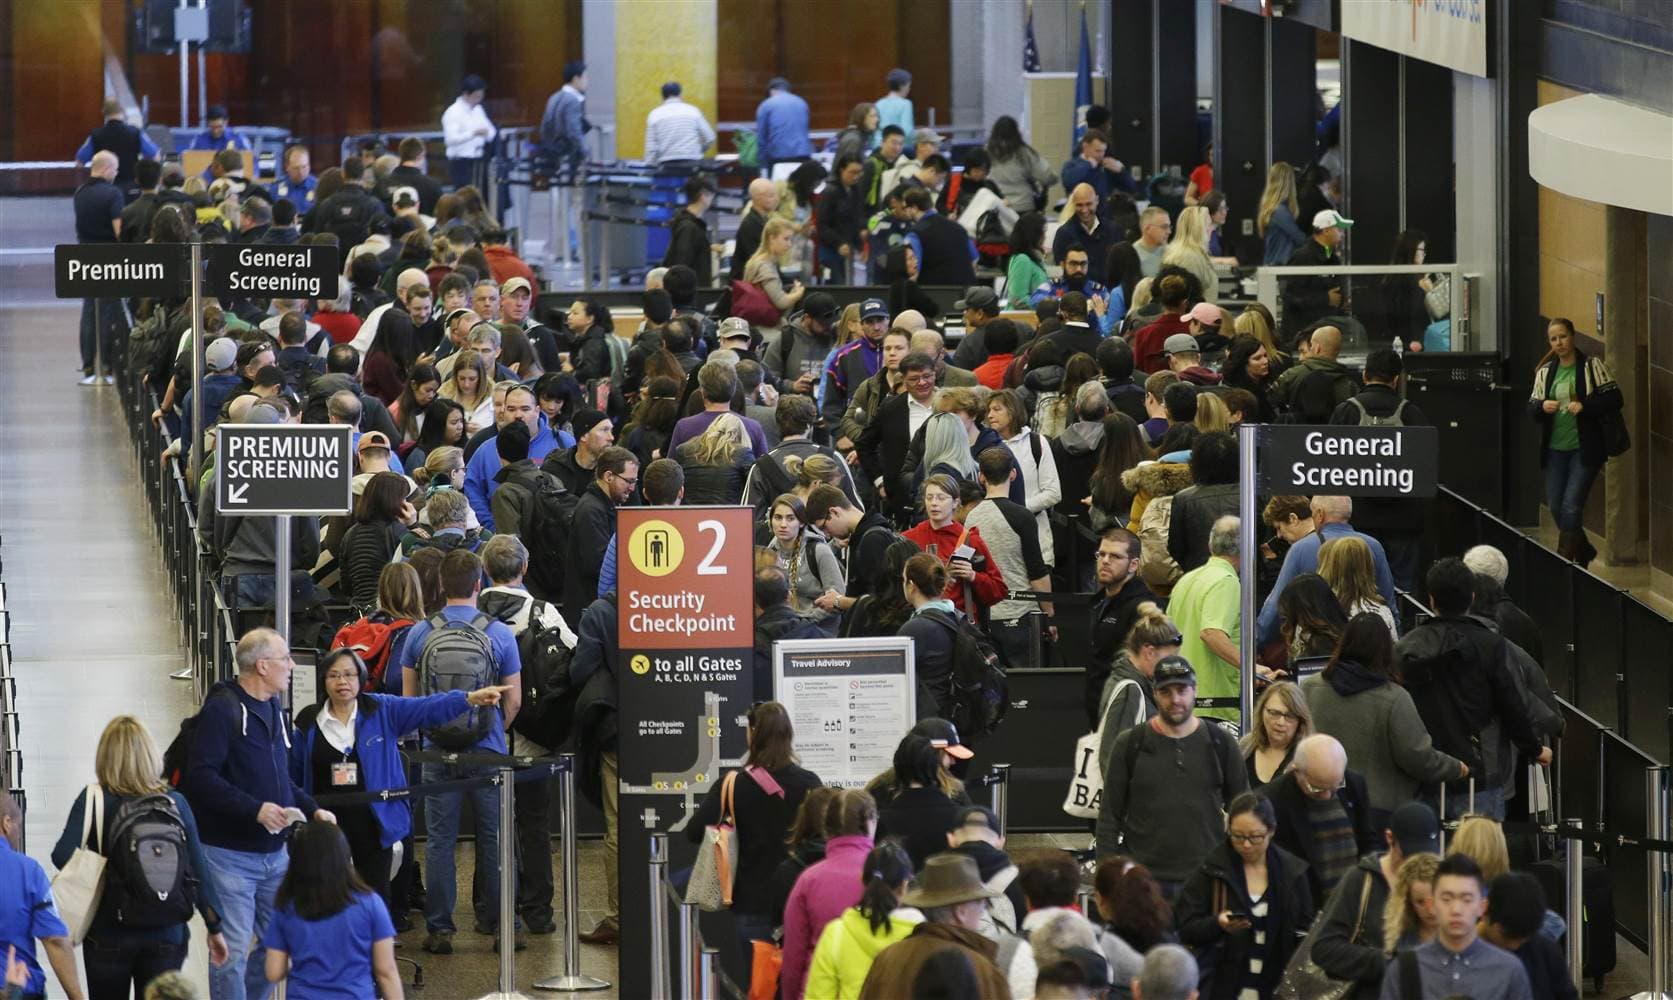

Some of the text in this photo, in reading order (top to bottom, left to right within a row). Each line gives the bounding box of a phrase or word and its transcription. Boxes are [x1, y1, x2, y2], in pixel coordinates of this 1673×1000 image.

[239, 248, 311, 268] General
[68, 258, 164, 281] Premium
[229, 271, 320, 296] Screening
[228, 436, 339, 458] PREMIUM
[1305, 431, 1402, 456] General
[227, 460, 339, 479] SCREENING
[1292, 461, 1414, 493] Screening
[697, 519, 728, 576] 2
[629, 590, 705, 613] Security
[629, 613, 736, 636] Checkpoint
[654, 655, 742, 672] to all Gates
[791, 659, 852, 669] Travel Advisory
[693, 674, 700, 682] N
[701, 674, 708, 682] &
[709, 673, 714, 681] S
[715, 673, 737, 681] Gates
[638, 728, 648, 736] go
[656, 727, 664, 735] all
[639, 720, 685, 730] All Checkpoints
[716, 727, 722, 737] 2
[1078, 748, 1094, 778] I
[663, 781, 669, 791] 5
[682, 781, 689, 791] 4
